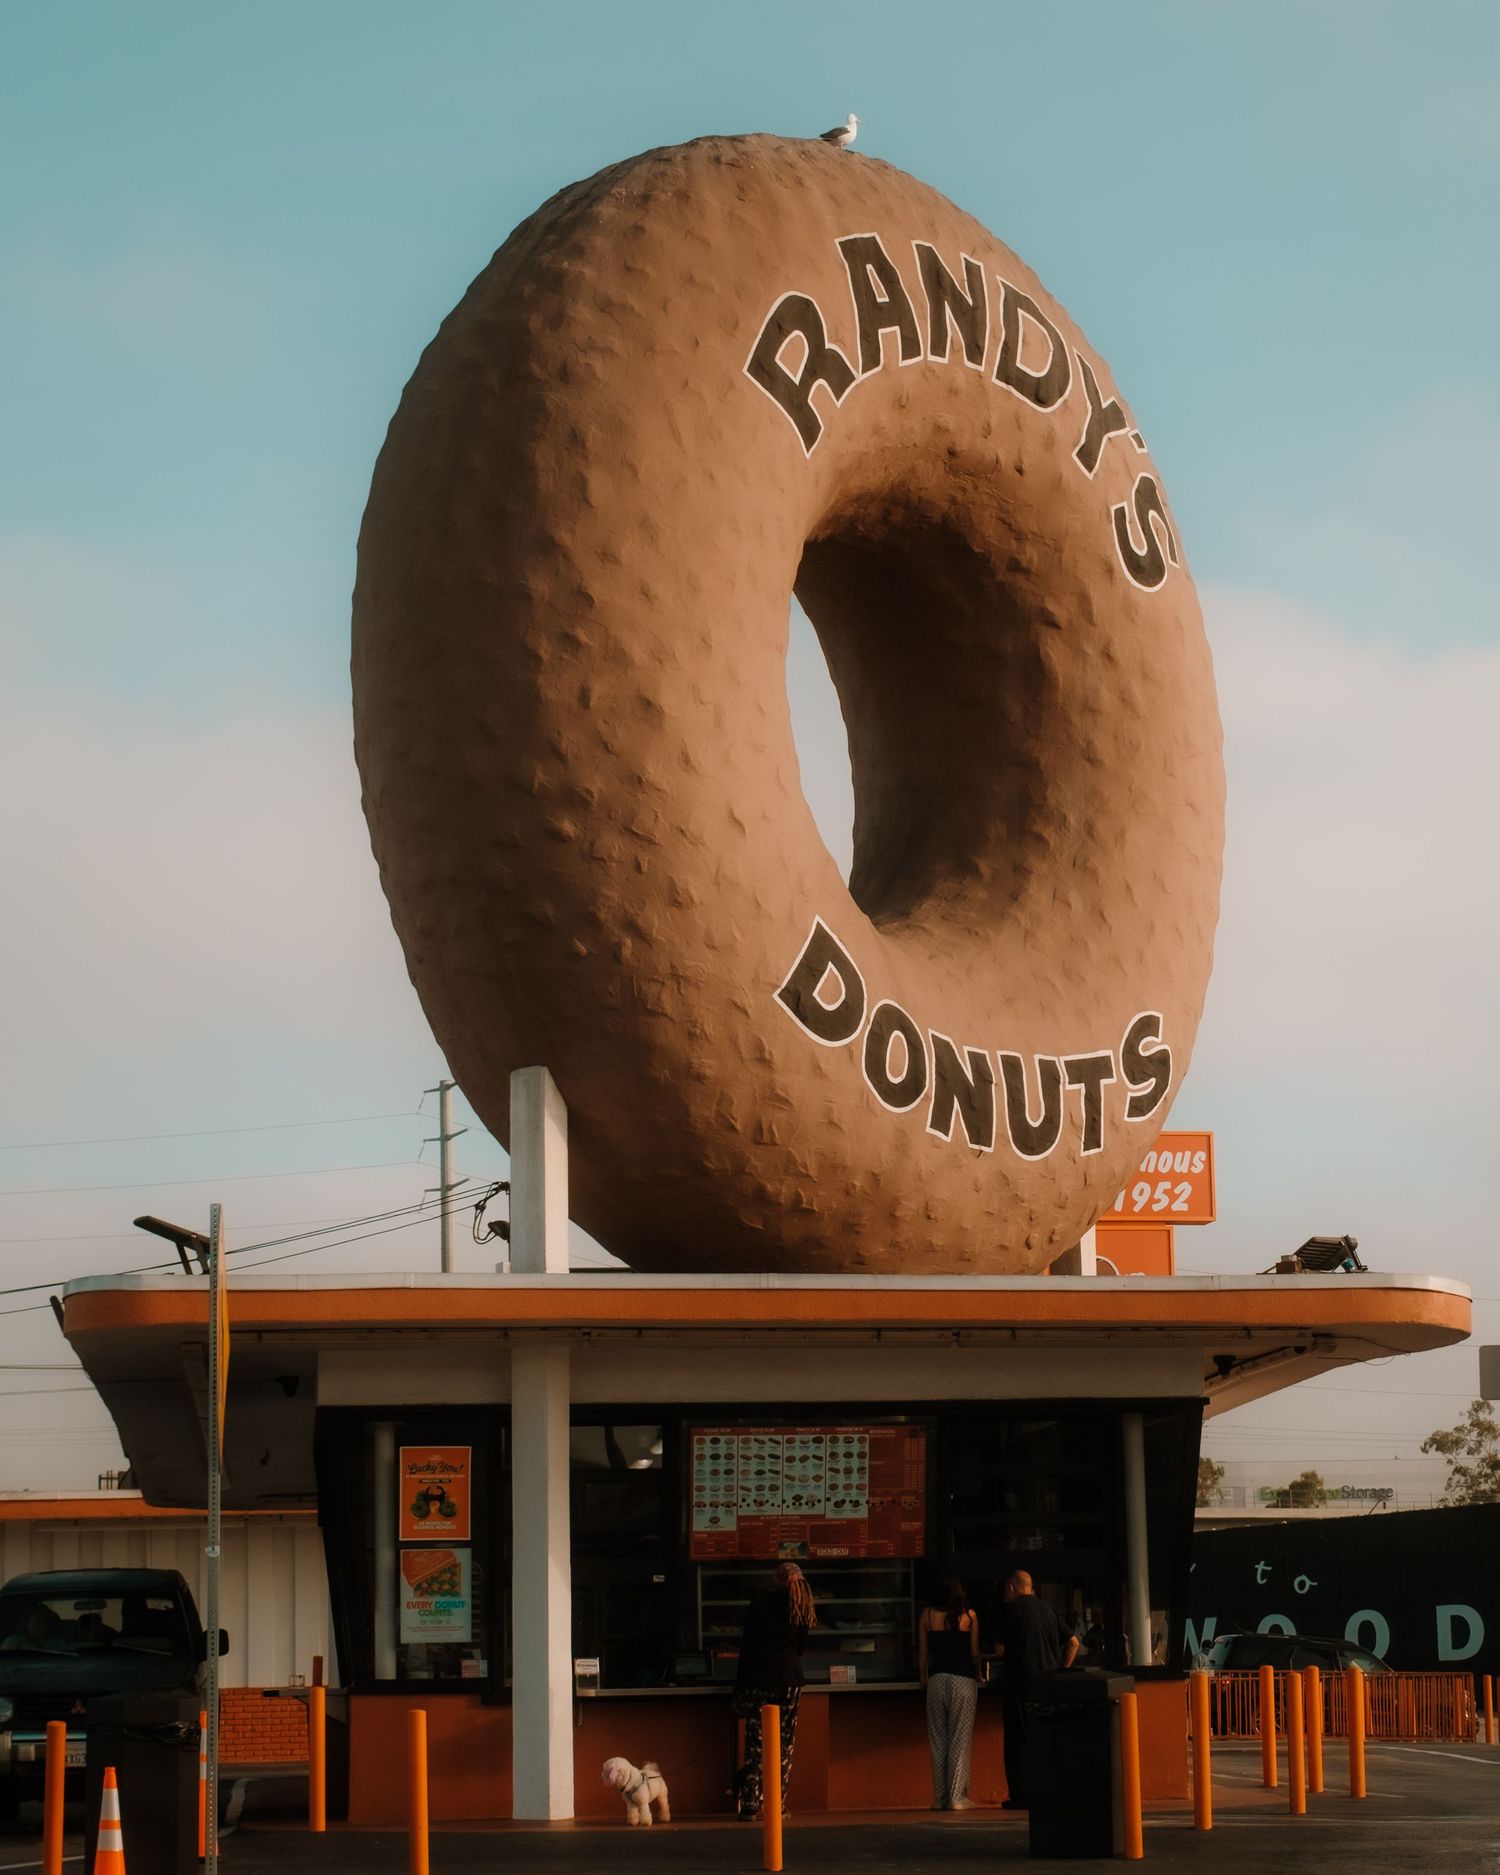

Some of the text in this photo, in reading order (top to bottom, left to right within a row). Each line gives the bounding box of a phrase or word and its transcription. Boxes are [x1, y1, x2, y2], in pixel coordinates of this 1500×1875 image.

[742, 232, 1180, 592] RANDY'S
[772, 915, 1172, 1161] DONUTS
[1114, 1181, 1192, 1213] 1952
[406, 1600, 465, 1609] EVERY DONUT
